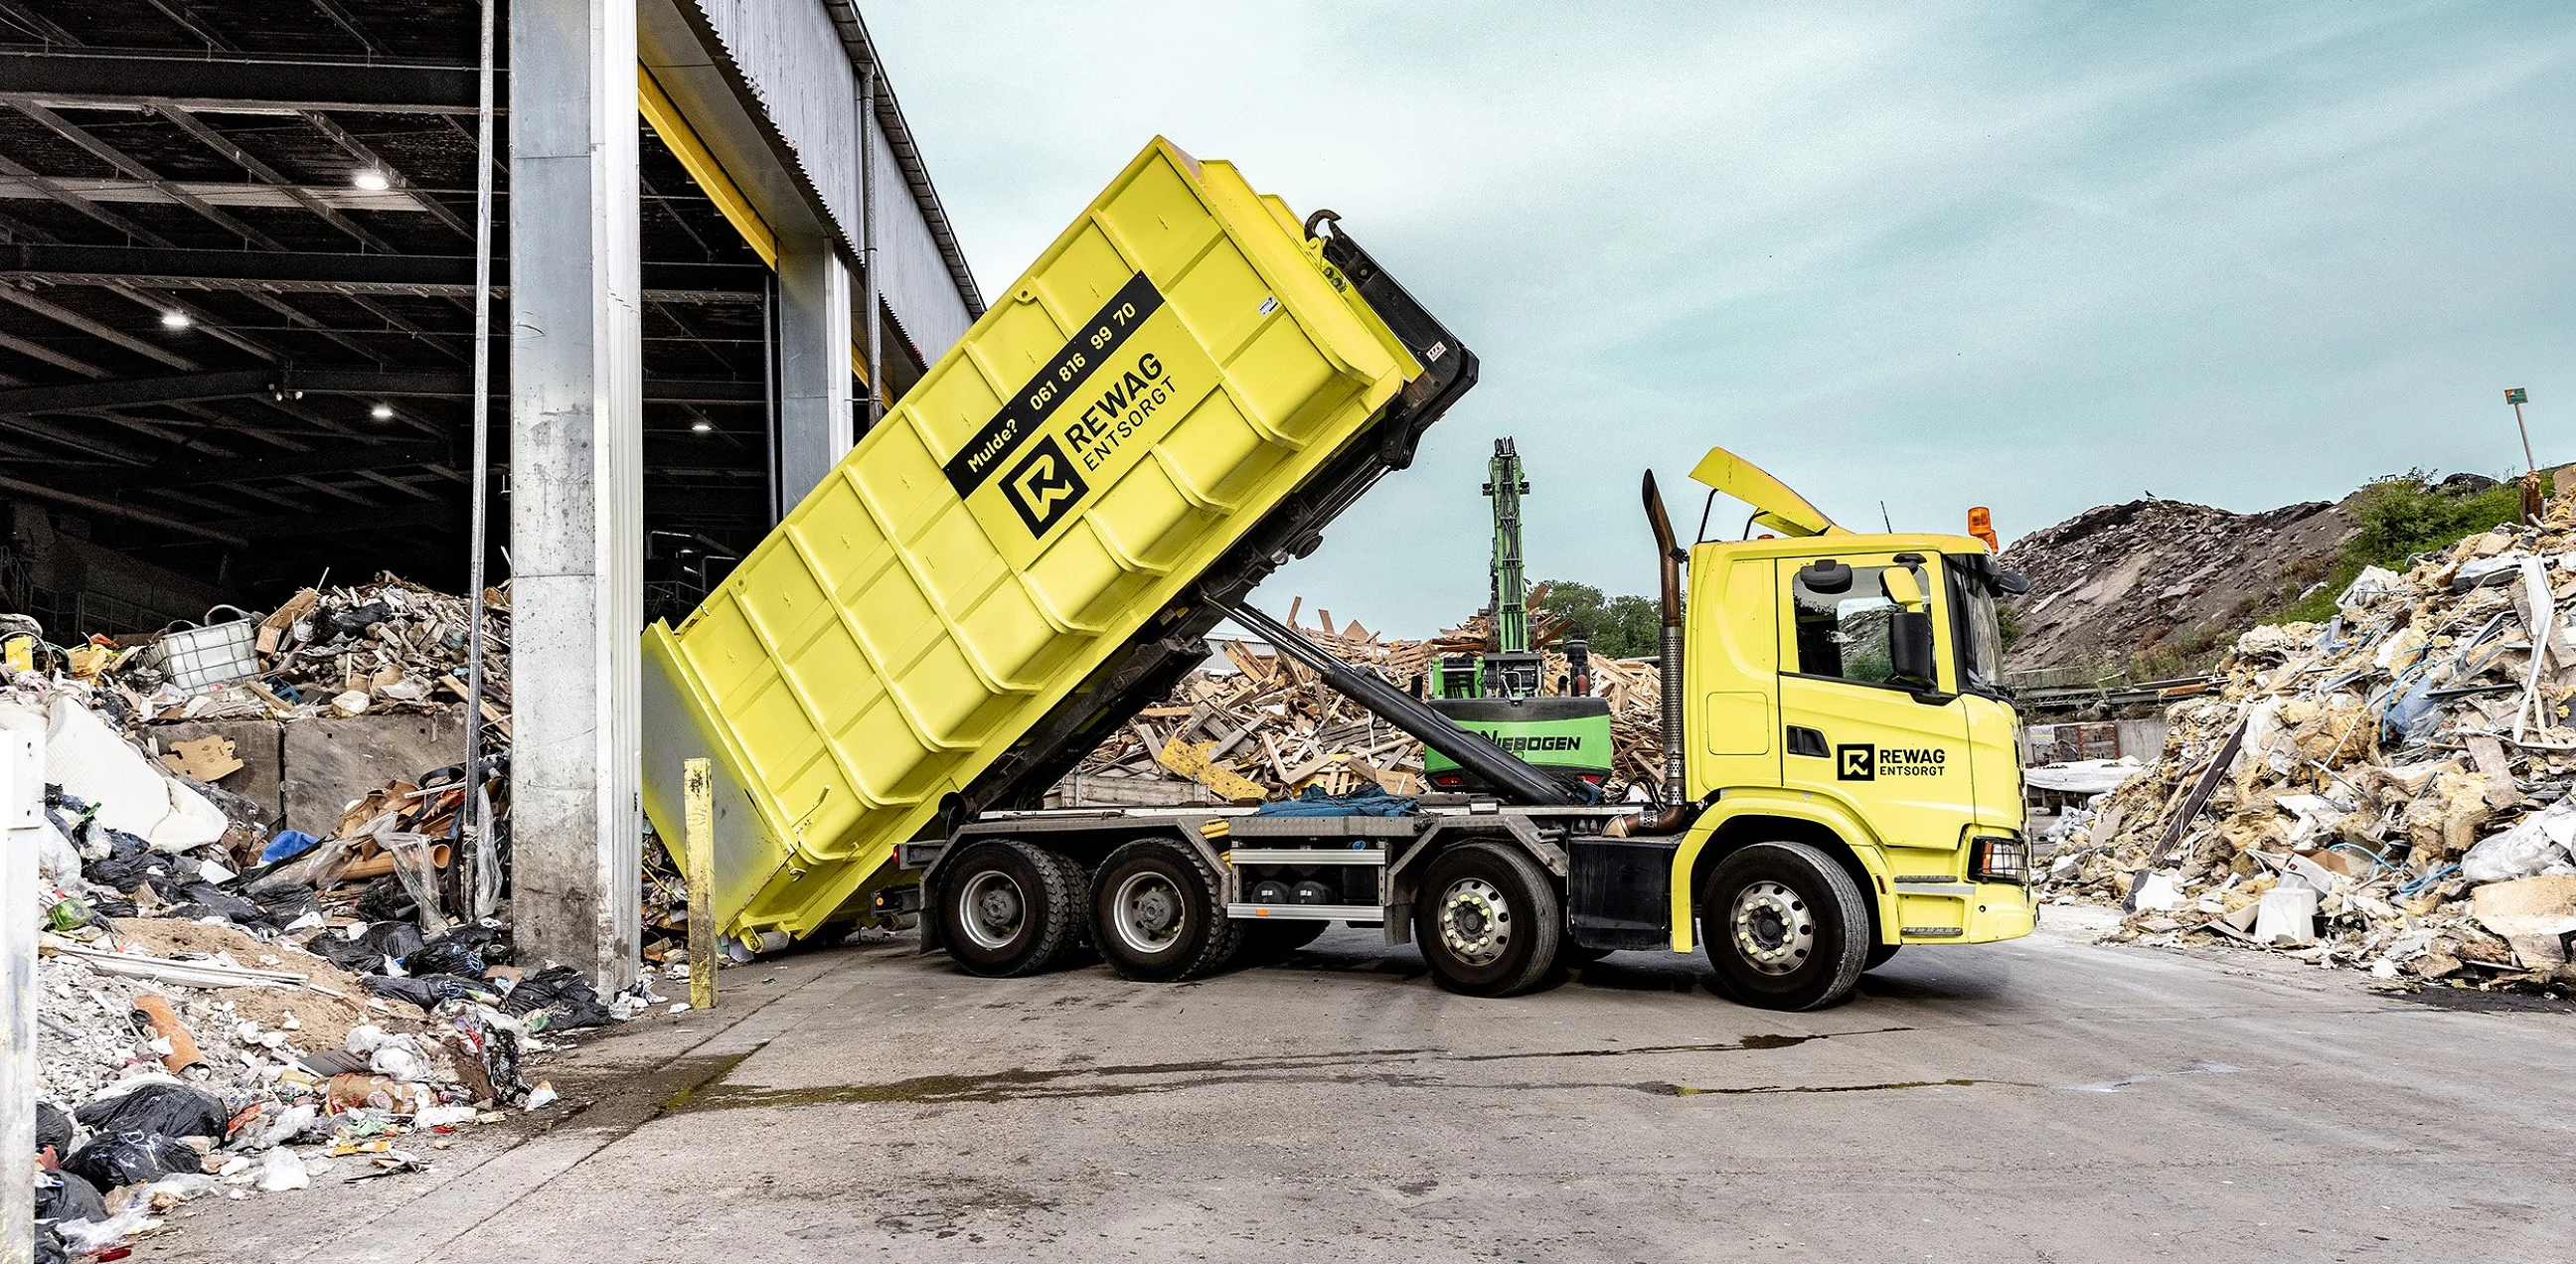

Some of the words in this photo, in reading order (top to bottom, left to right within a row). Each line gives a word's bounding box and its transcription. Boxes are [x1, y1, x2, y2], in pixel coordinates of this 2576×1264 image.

[967, 418, 1018, 473] Mulde?
[1030, 380, 1058, 410] 061
[1058, 352, 1086, 383] 816
[1090, 326, 1113, 350] 99
[1112, 302, 1136, 326] 70
[1063, 353, 1163, 454] REWAG
[1083, 376, 1177, 472] ENTSORGT
[1879, 749, 1945, 764] REWAG
[1879, 765, 1945, 776] ENTSORGT
